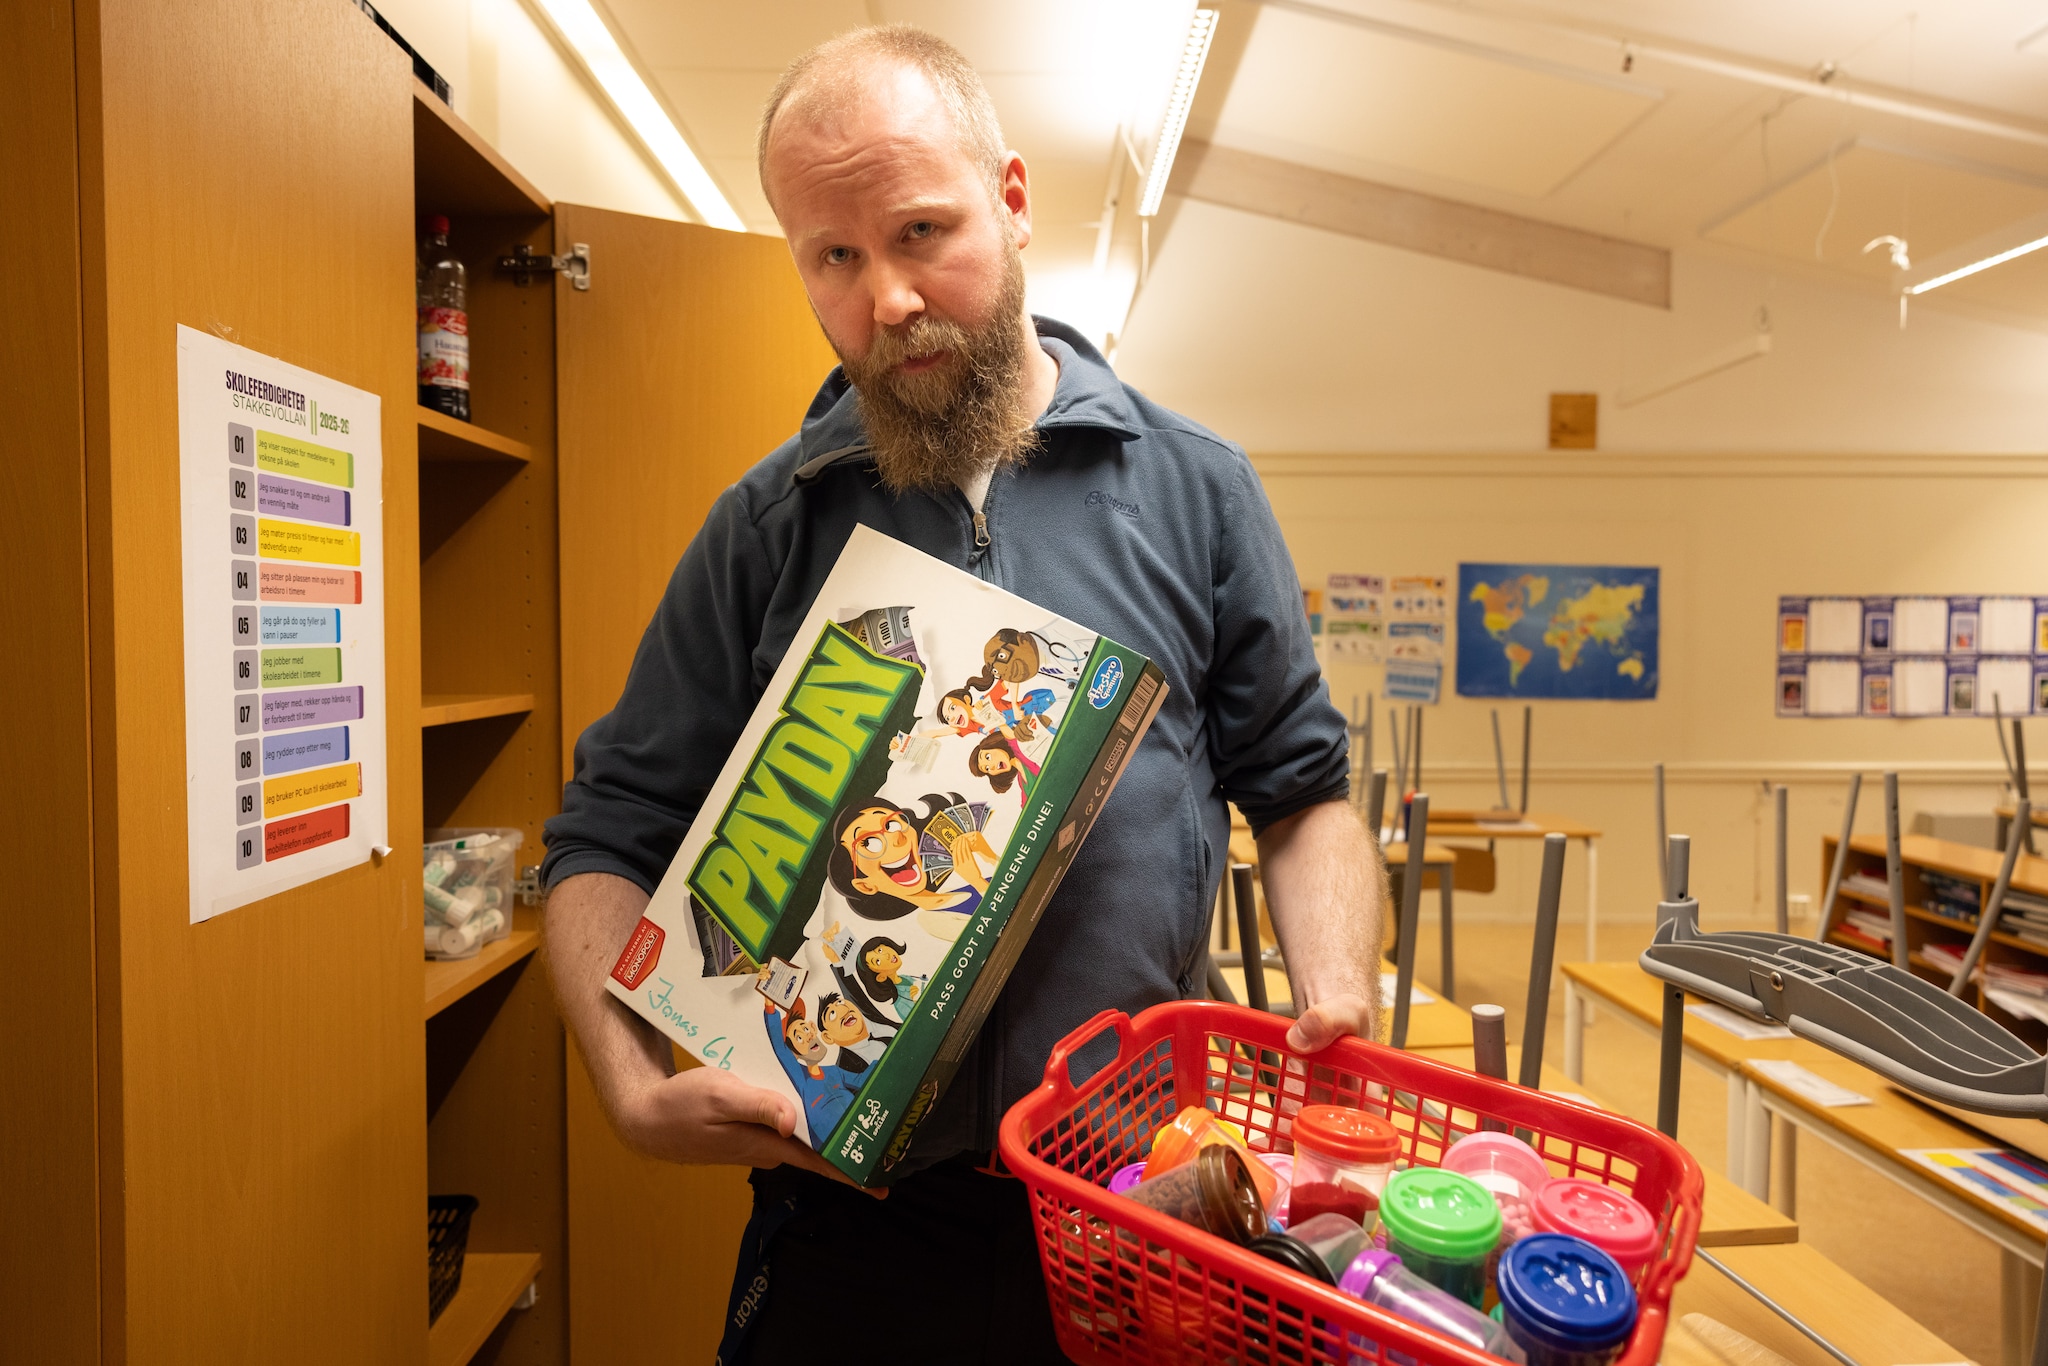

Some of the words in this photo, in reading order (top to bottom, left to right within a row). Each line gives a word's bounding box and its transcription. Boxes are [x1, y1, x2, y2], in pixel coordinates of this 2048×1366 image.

[226, 370, 305, 412] SKOLEFERDIGHETER
[233, 394, 306, 426] STAKKEVOLLAN
[320, 412, 349, 434] 2025-26
[235, 436, 244, 453] 01
[259, 440, 267, 449] Jeg
[268, 442, 279, 450] viser
[281, 444, 298, 455] respekt
[306, 451, 328, 462] medelever
[330, 457, 335, 466] og
[259, 453, 276, 463] voksne
[277, 456, 283, 466] på
[285, 457, 300, 468] skolen
[236, 481, 246, 498] 02
[260, 483, 268, 493] Jeg
[270, 485, 289, 495] snakker
[296, 491, 302, 500] og
[311, 493, 323, 501] andre
[268, 499, 285, 509] vennlig
[287, 501, 299, 510] måte
[1085, 491, 1140, 517] Bergans
[236, 527, 247, 544] 03
[260, 528, 269, 538] Jeg
[287, 532, 301, 540] presis
[260, 542, 286, 553] nødvendig
[288, 544, 302, 554] utstyr
[237, 572, 248, 589] 04
[260, 572, 269, 582] Jeg
[271, 573, 284, 581] sitter
[285, 573, 291, 583] på
[293, 574, 311, 583] plassen
[327, 576, 338, 584] bidrar
[260, 586, 285, 595] arbeidsro
[289, 587, 306, 595] timene
[238, 617, 248, 634] 05
[263, 616, 272, 626] Jeg
[273, 616, 282, 626] går
[283, 616, 290, 626] på
[291, 616, 298, 625] do
[299, 618, 306, 626] og
[307, 617, 319, 626] fyller
[320, 617, 326, 626] på
[280, 632, 298, 640] pauser
[879, 621, 892, 647] 1000
[239, 662, 249, 678] 06
[263, 657, 272, 667] Jeg
[273, 657, 291, 667] jobber
[292, 656, 303, 664] med
[263, 671, 299, 681] skolearbeidet
[303, 670, 320, 678] timene
[1088, 661, 1117, 704] Hasbro
[1101, 671, 1124, 699] Gaming
[264, 702, 273, 711] Jeg
[275, 701, 290, 710] følger
[291, 699, 303, 707] med,
[304, 698, 320, 706] rekker
[240, 706, 250, 723] 07
[272, 713, 295, 723] forberedt
[303, 712, 316, 720] timer
[241, 751, 251, 768] 08
[265, 750, 275, 760] Jeg
[277, 747, 294, 758] rydder
[296, 746, 305, 756] opp
[307, 744, 318, 752] etter
[320, 742, 331, 751] meg
[266, 795, 275, 805] Jeg
[276, 791, 294, 801] bruker
[303, 787, 312, 795] kun
[319, 780, 346, 792] skolearbeid
[693, 630, 910, 955] PAYDAY
[242, 795, 252, 813] 09
[267, 831, 276, 840] Jeg
[277, 825, 296, 836] leverer
[242, 840, 251, 858] 10
[267, 839, 301, 855] mobiltelefon
[302, 830, 332, 845] uoppfordret
[930, 983, 955, 1020] PASS
[953, 938, 979, 979] GODT
[976, 916, 993, 935] PÅ
[990, 843, 1031, 913] PENGENE
[1027, 801, 1054, 841] DINE!
[617, 964, 626, 975] FRA
[625, 934, 642, 963] SKAPERNE
[641, 924, 647, 933] AV
[626, 932, 656, 982] MONOPOLY
[840, 936, 855, 961] AVTALE
[648, 977, 698, 1037] Jonas
[702, 1036, 735, 1071] 6b
[873, 1110, 889, 1136] SPILLERE
[888, 1092, 935, 1159] PAYDAY
[840, 1130, 859, 1158] ALDER
[850, 1144, 863, 1164] 8+
